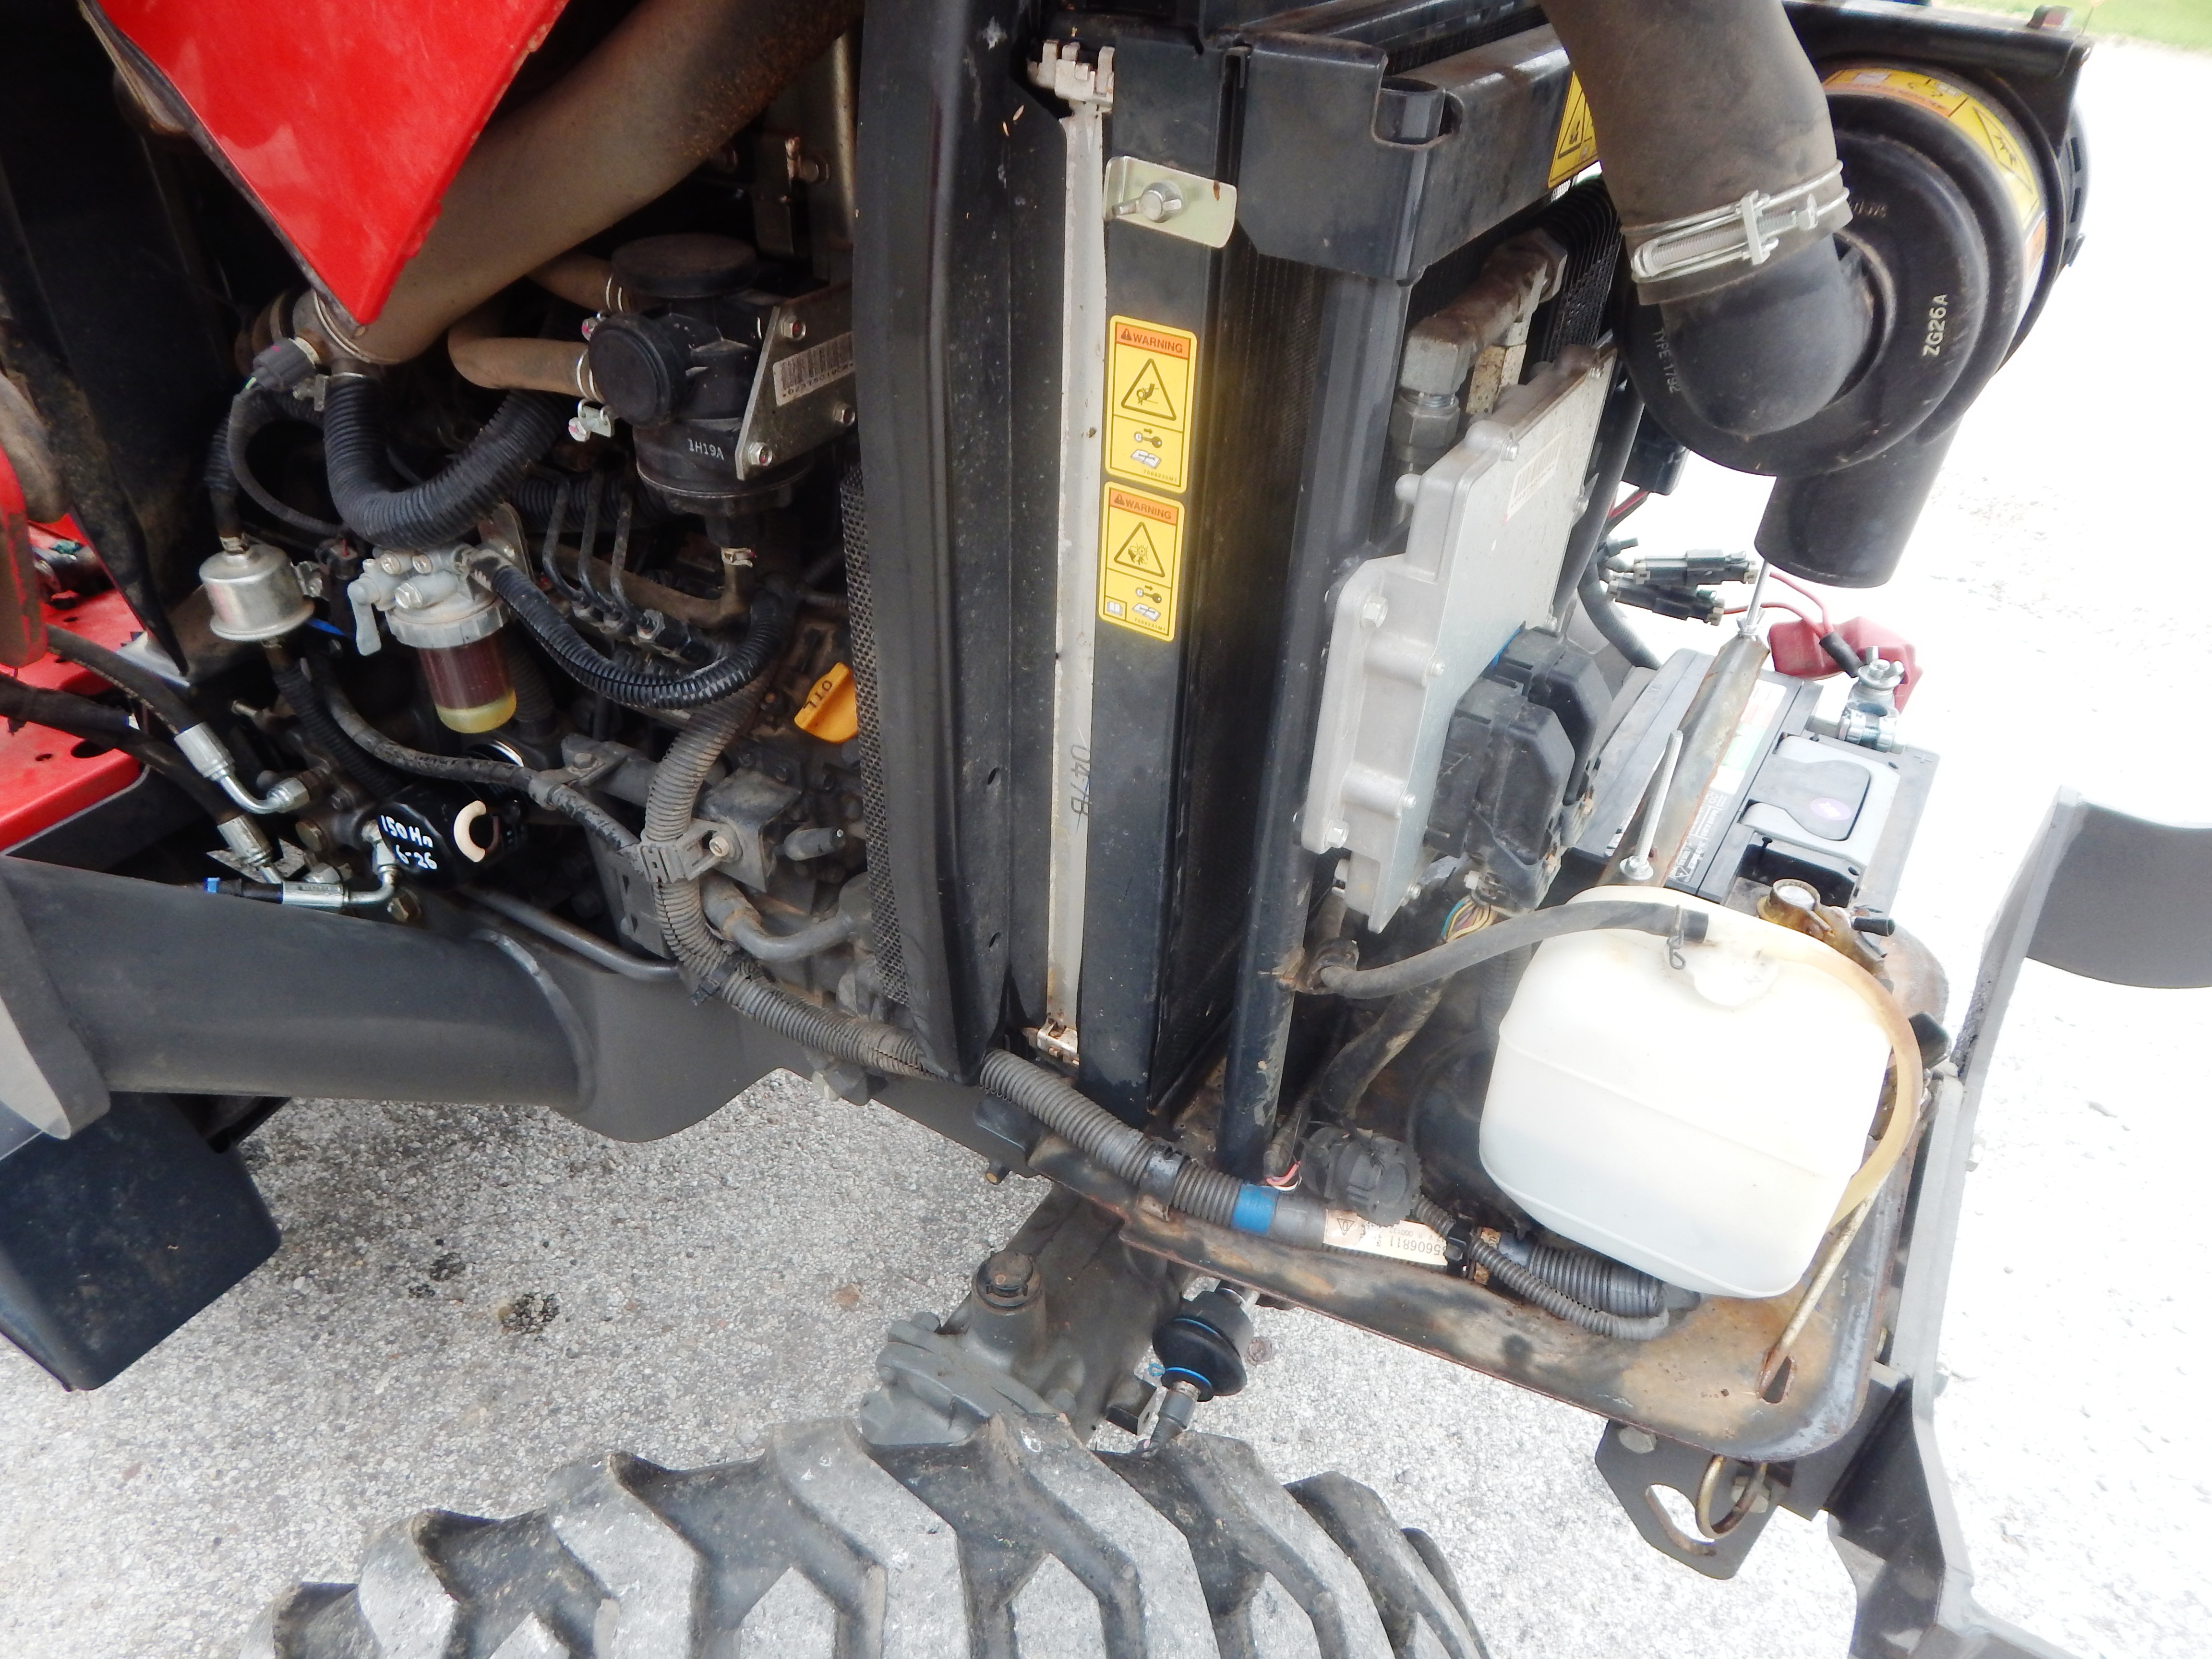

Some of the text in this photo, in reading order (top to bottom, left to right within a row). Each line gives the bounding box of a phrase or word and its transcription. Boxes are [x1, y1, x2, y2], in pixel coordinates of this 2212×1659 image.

[1922, 294, 1948, 357] ZG26A
[1133, 333, 1183, 353] WARNING
[688, 438, 724, 461] 1H19A
[1126, 498, 1171, 519] WARNING
[802, 680, 833, 709] OIL
[396, 844, 438, 870] 6-26
